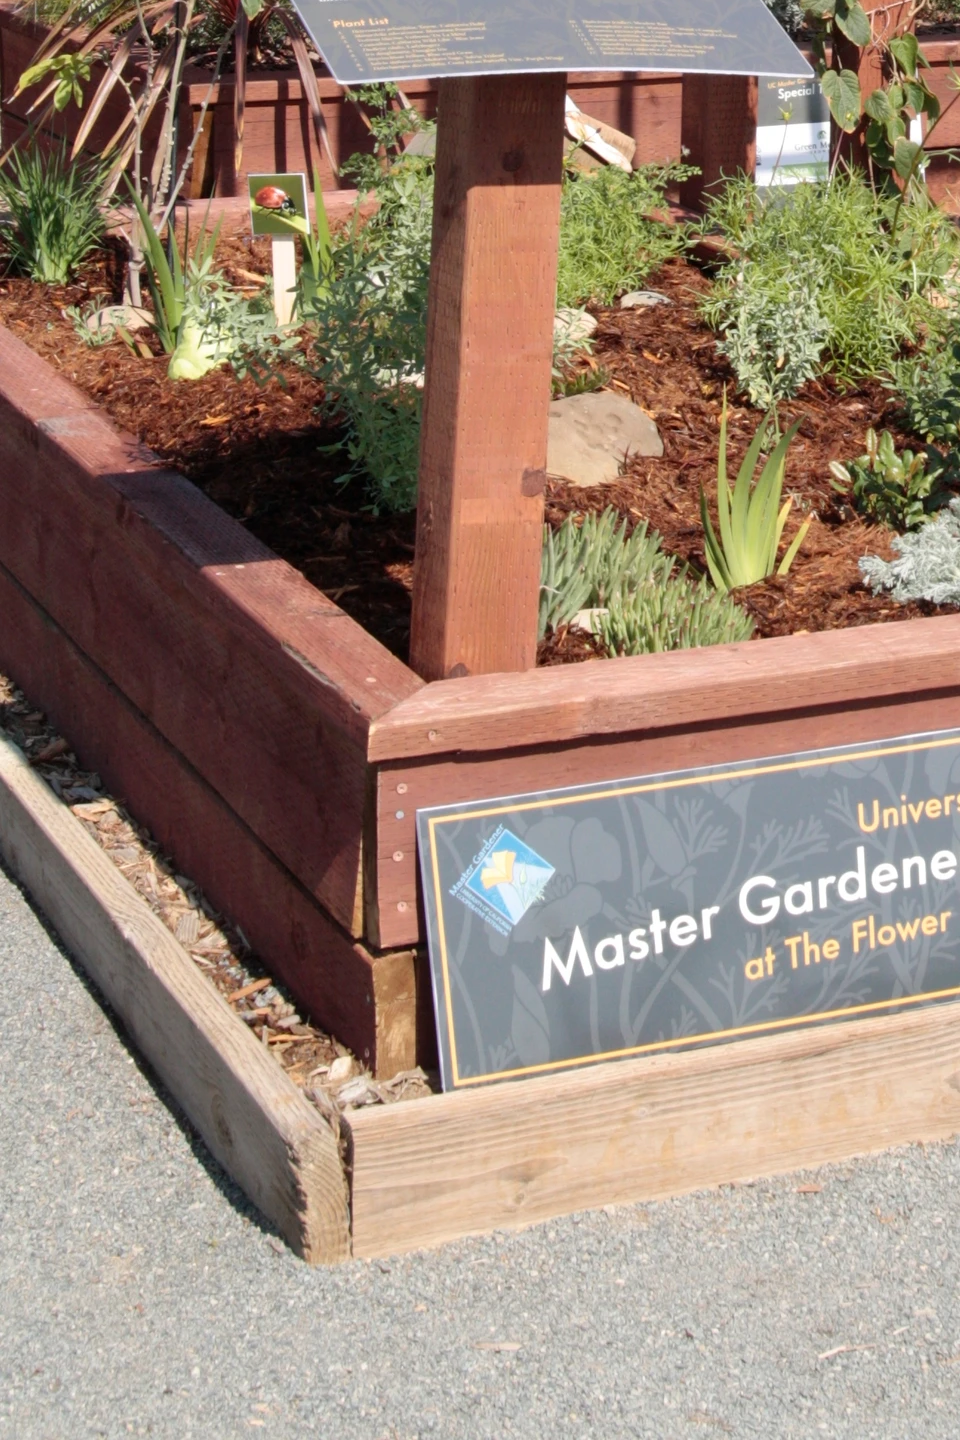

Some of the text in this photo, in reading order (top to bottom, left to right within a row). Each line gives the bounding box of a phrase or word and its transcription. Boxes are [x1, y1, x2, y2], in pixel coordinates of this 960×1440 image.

[333, 19, 365, 28] Plant
[778, 84, 815, 101] Special
[795, 143, 817, 151] Green
[449, 823, 503, 896] Master Gardener
[541, 904, 721, 992] Master
[744, 946, 776, 981] at
[783, 931, 841, 970] The
[852, 912, 952, 954] Flower
